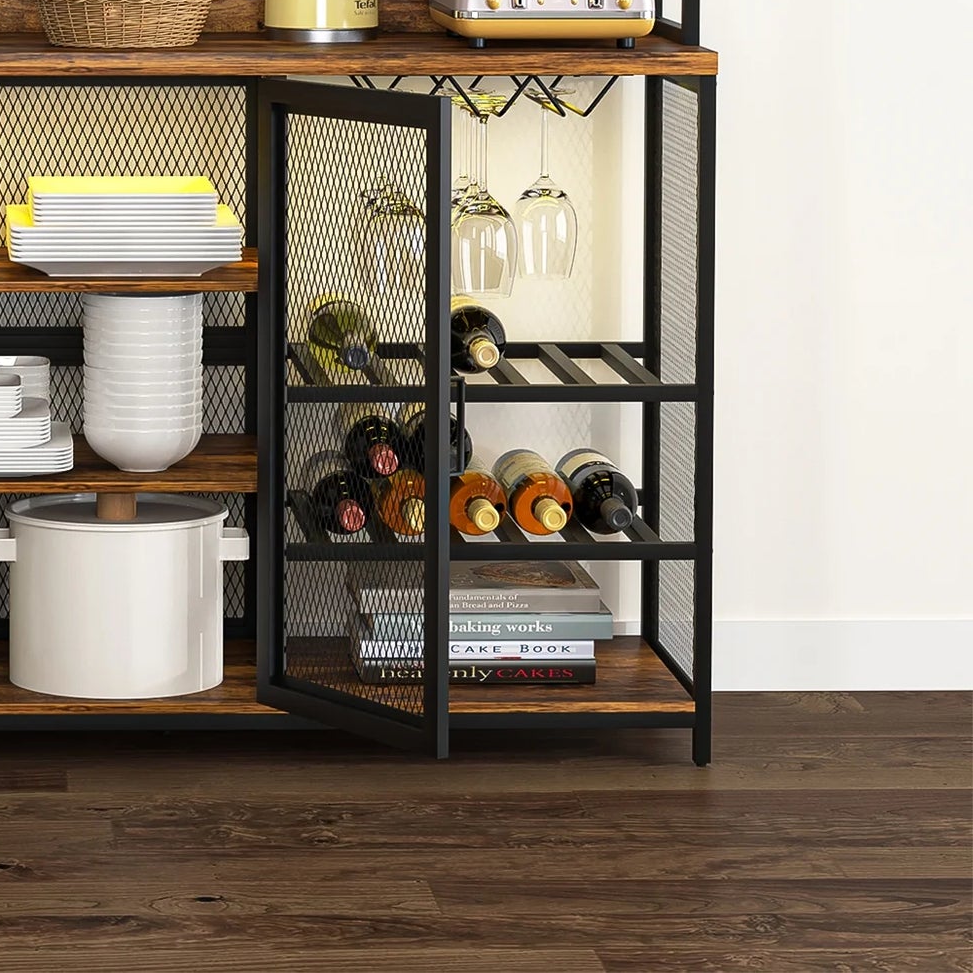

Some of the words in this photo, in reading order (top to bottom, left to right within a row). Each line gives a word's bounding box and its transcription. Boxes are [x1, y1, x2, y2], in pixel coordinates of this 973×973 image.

[354, 0, 376, 9] Tefal
[449, 620, 502, 636] baking
[506, 620, 553, 633] works
[450, 644, 502, 653] CAKE
[519, 644, 572, 653] BOOK
[380, 665, 493, 682] heanly
[494, 668, 574, 679] CAKES
